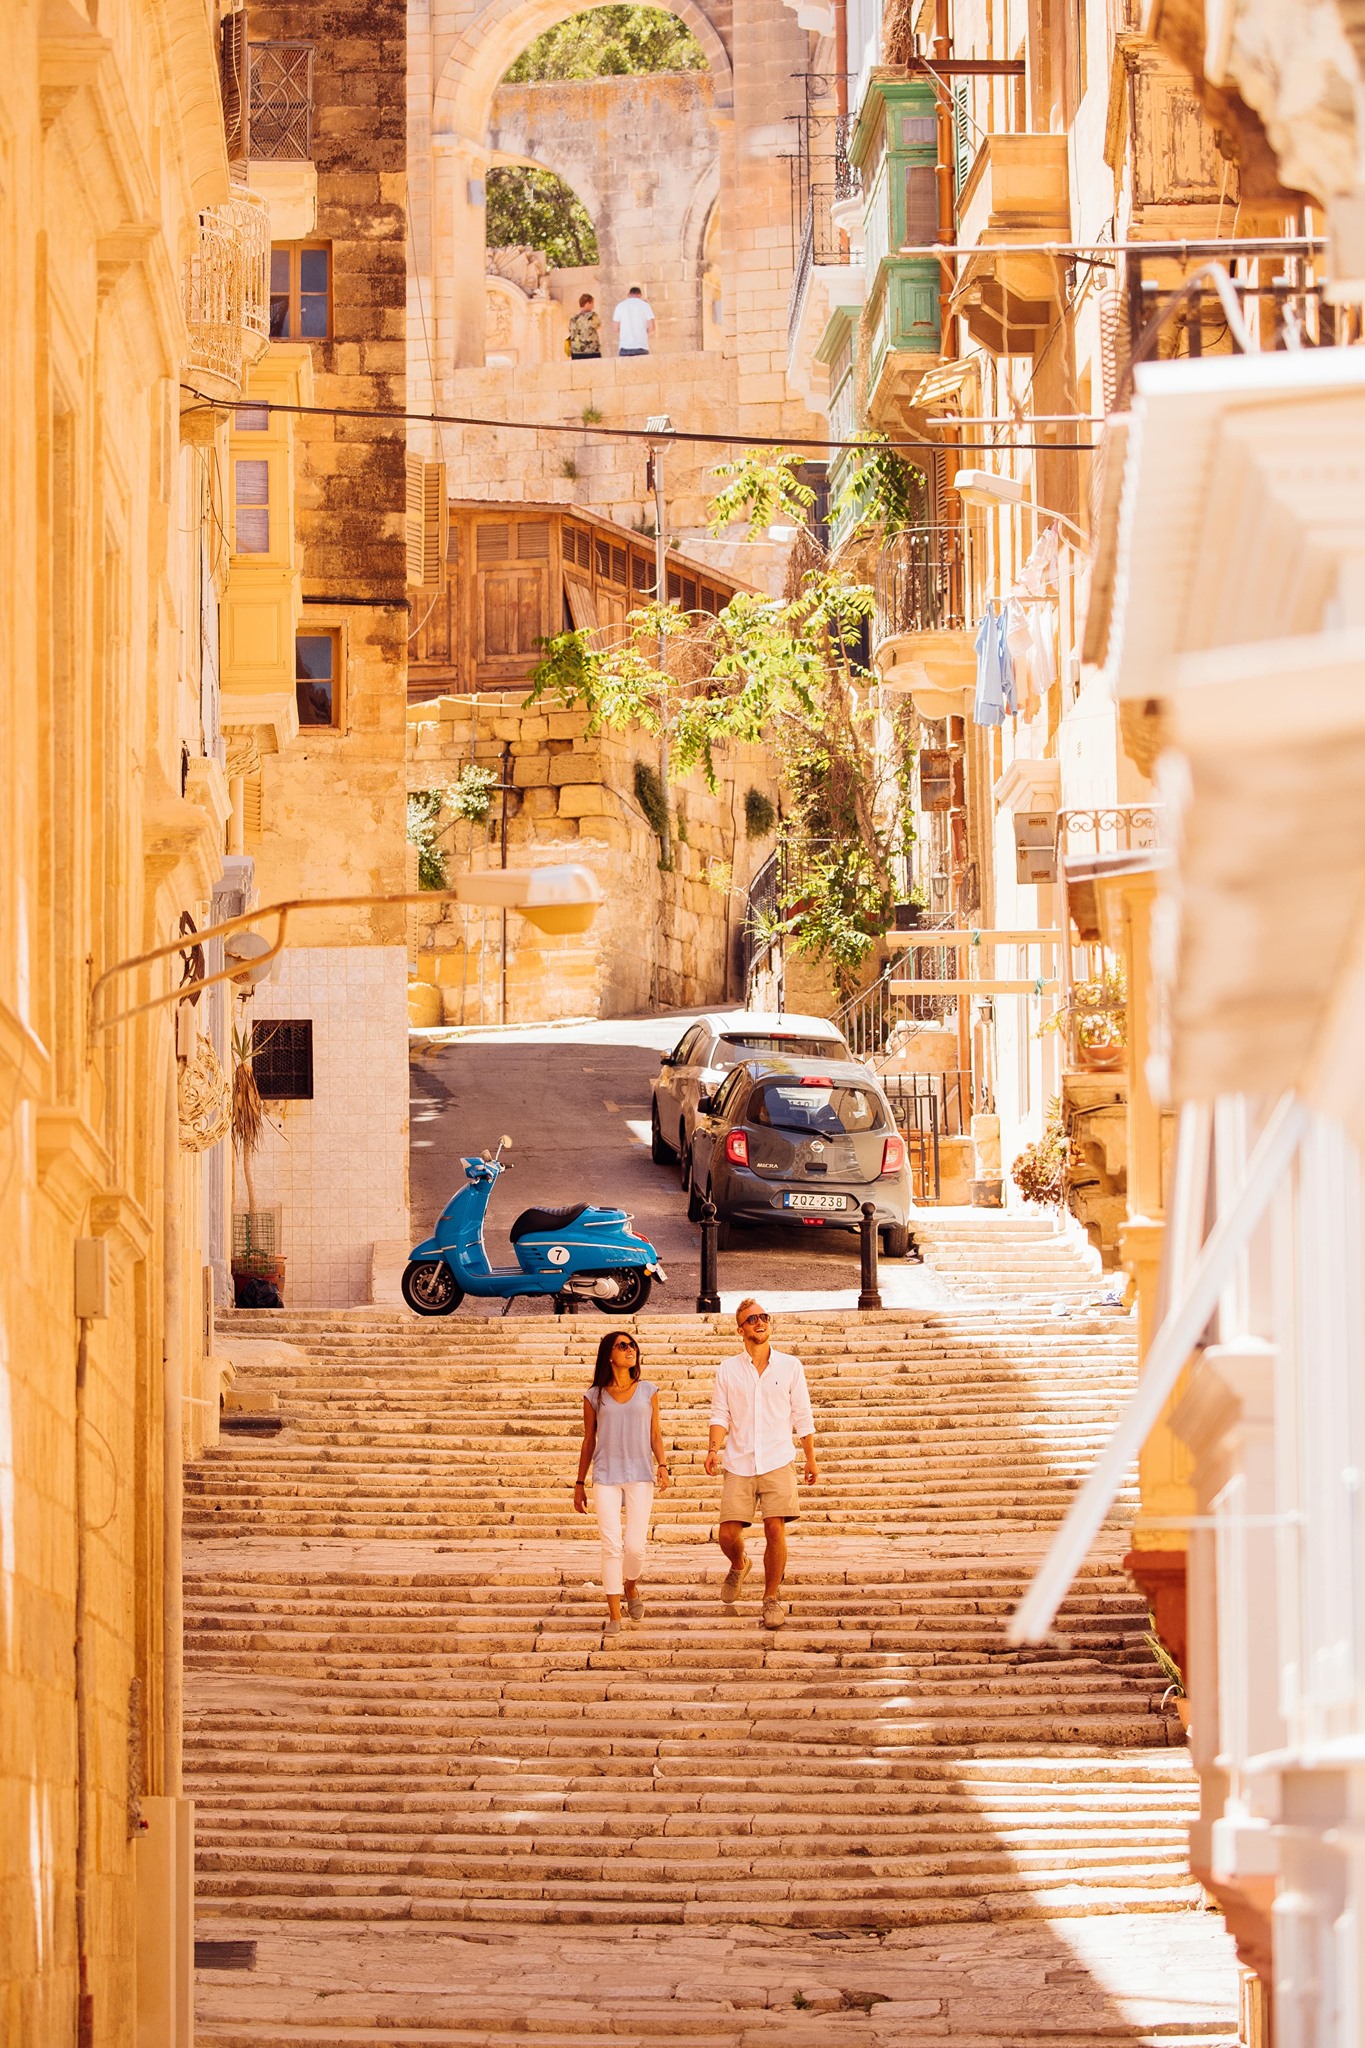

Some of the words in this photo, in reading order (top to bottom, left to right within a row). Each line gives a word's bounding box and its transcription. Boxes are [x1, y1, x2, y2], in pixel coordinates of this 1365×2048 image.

[792, 1195, 815, 1206] ZQZ
[820, 1196, 843, 1207] 238
[555, 1250, 562, 1260] 7
